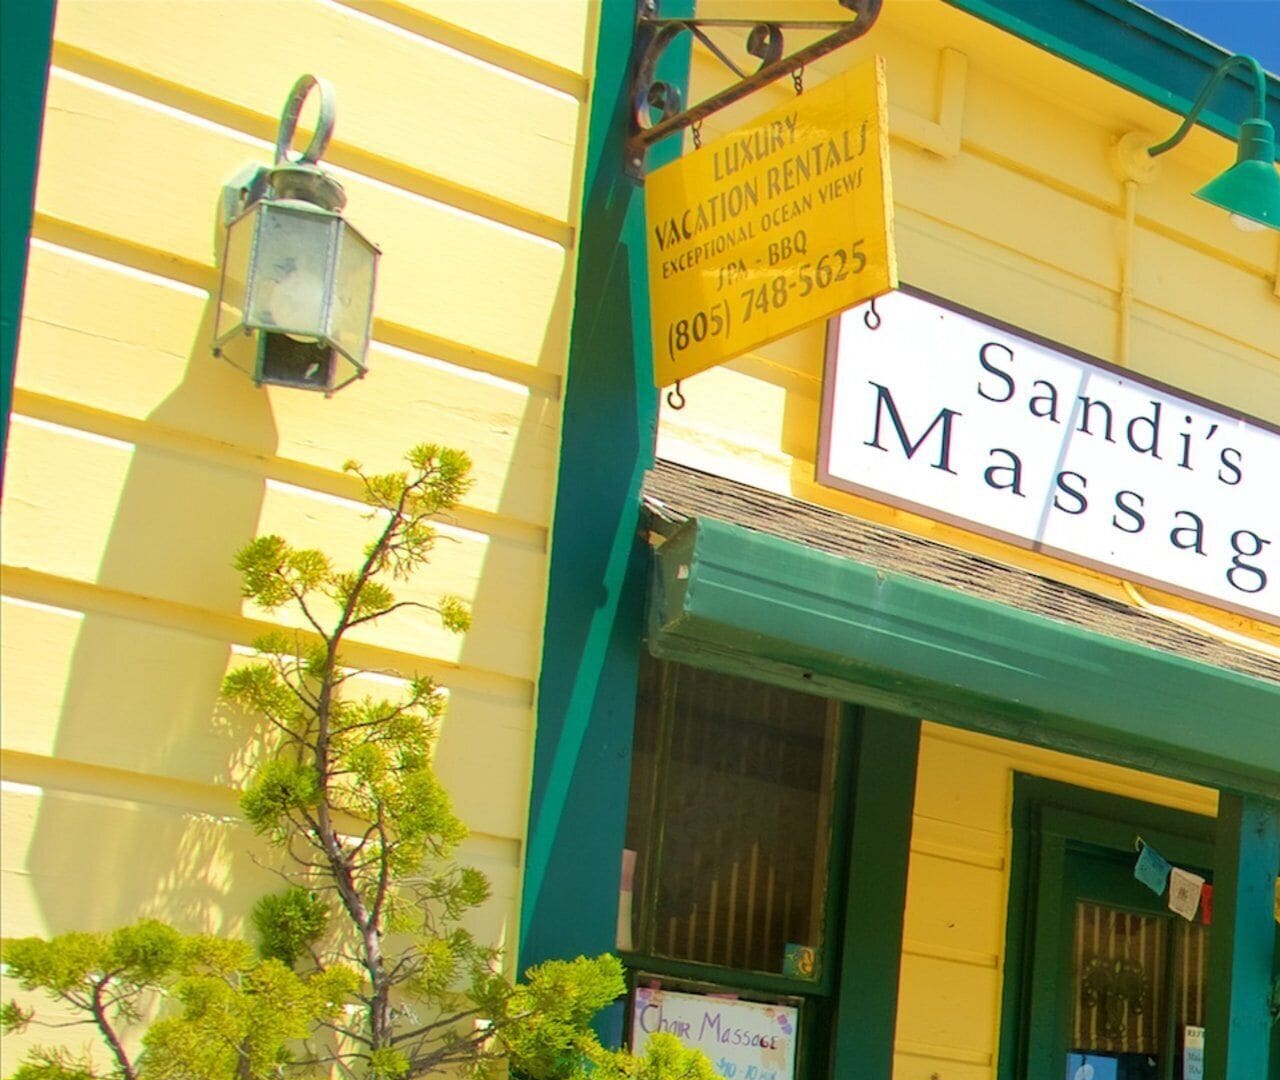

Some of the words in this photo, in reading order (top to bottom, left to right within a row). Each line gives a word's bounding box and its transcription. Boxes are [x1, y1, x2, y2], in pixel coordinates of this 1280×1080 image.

[655, 181, 761, 252] VACATION
[766, 119, 870, 201] RENTALS
[713, 112, 799, 183] LUXURY
[662, 221, 756, 280] EXCEPTIONAL
[761, 190, 813, 232] OCEAN
[818, 167, 864, 206] VIEWS
[717, 259, 749, 292] SPA
[768, 229, 808, 267] BBQ
[667, 299, 732, 361] (805)
[741, 240, 868, 325] 748-5625
[976, 341, 1244, 486] Sandi's
